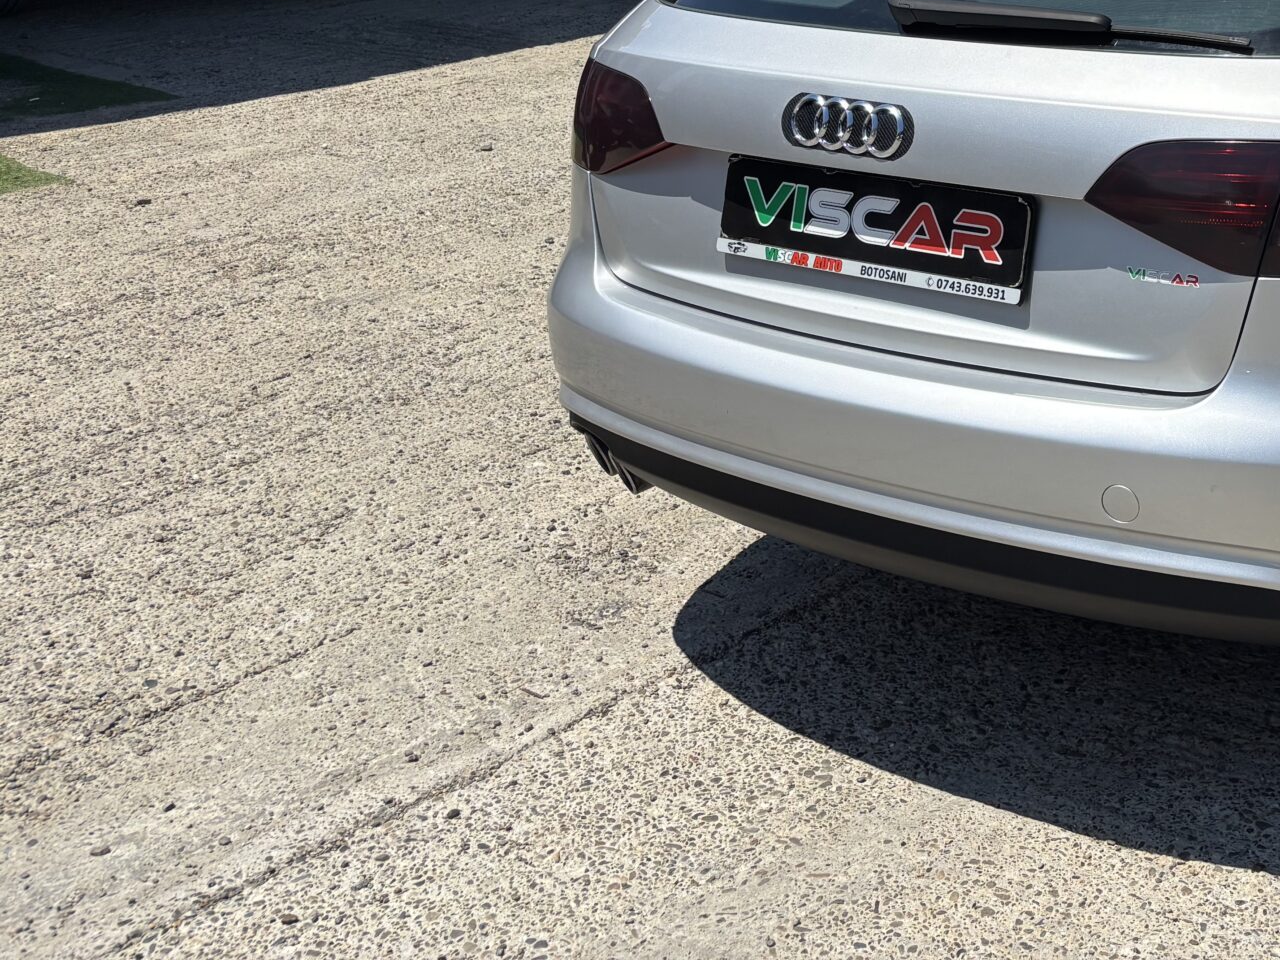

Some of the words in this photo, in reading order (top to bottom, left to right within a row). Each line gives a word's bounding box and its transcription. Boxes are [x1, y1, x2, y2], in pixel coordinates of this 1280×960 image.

[743, 175, 1004, 266] VISCAR
[764, 246, 809, 267] VISCAR
[812, 254, 843, 273] AUTO
[859, 264, 907, 284] BOTOSANI
[936, 278, 1006, 301] 0743.639.931
[1126, 266, 1200, 288] VISCAR
